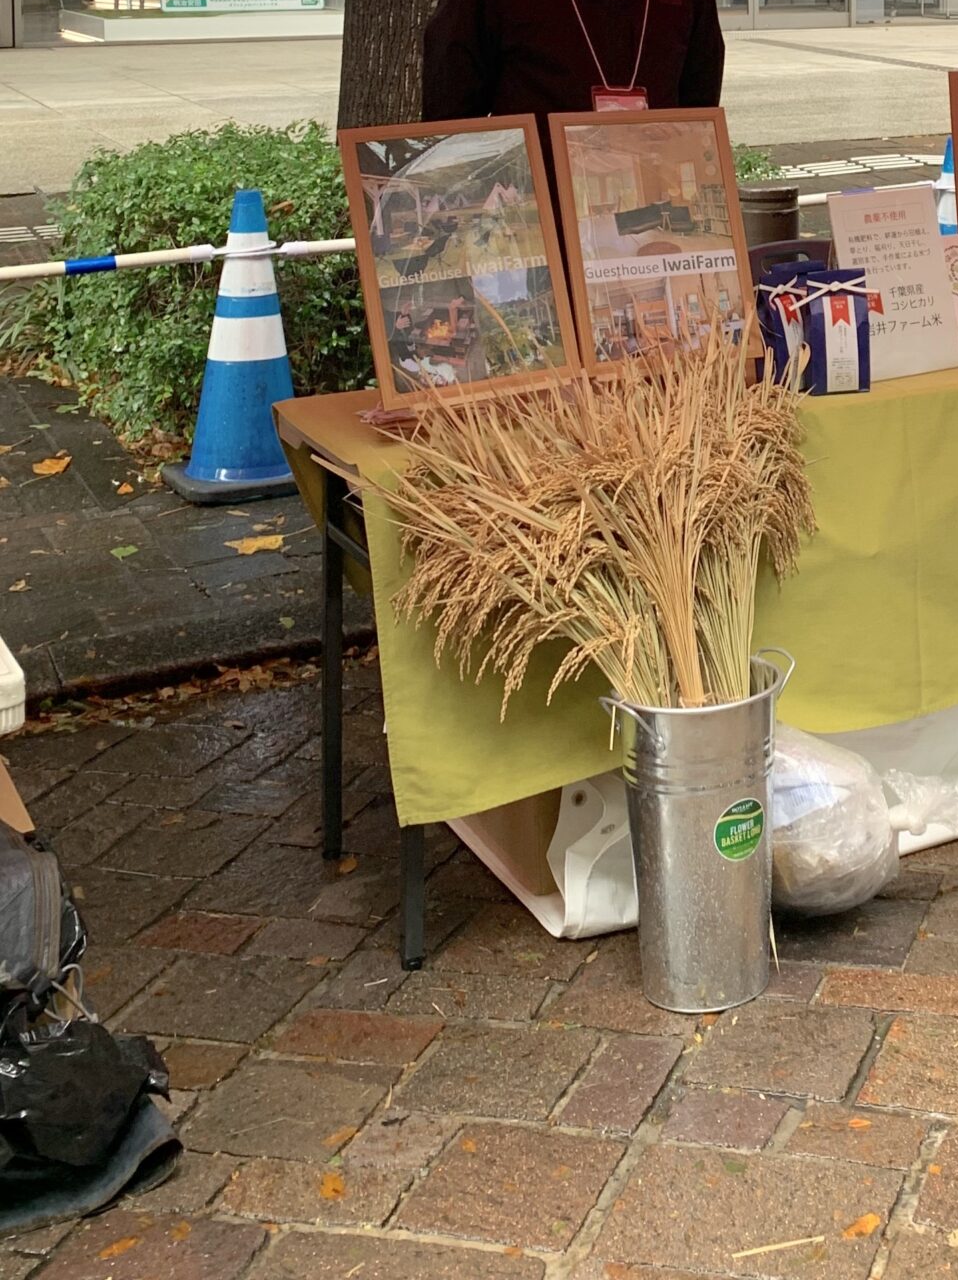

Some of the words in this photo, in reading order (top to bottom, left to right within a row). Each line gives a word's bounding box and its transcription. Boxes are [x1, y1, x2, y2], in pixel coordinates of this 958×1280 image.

[378, 267, 462, 288] Guesthouse
[465, 254, 548, 277] IwaiFarm
[584, 263, 660, 280] Guesthouse
[662, 254, 736, 273] IwaiFarm
[891, 295, 935, 311] コシヒカリ
